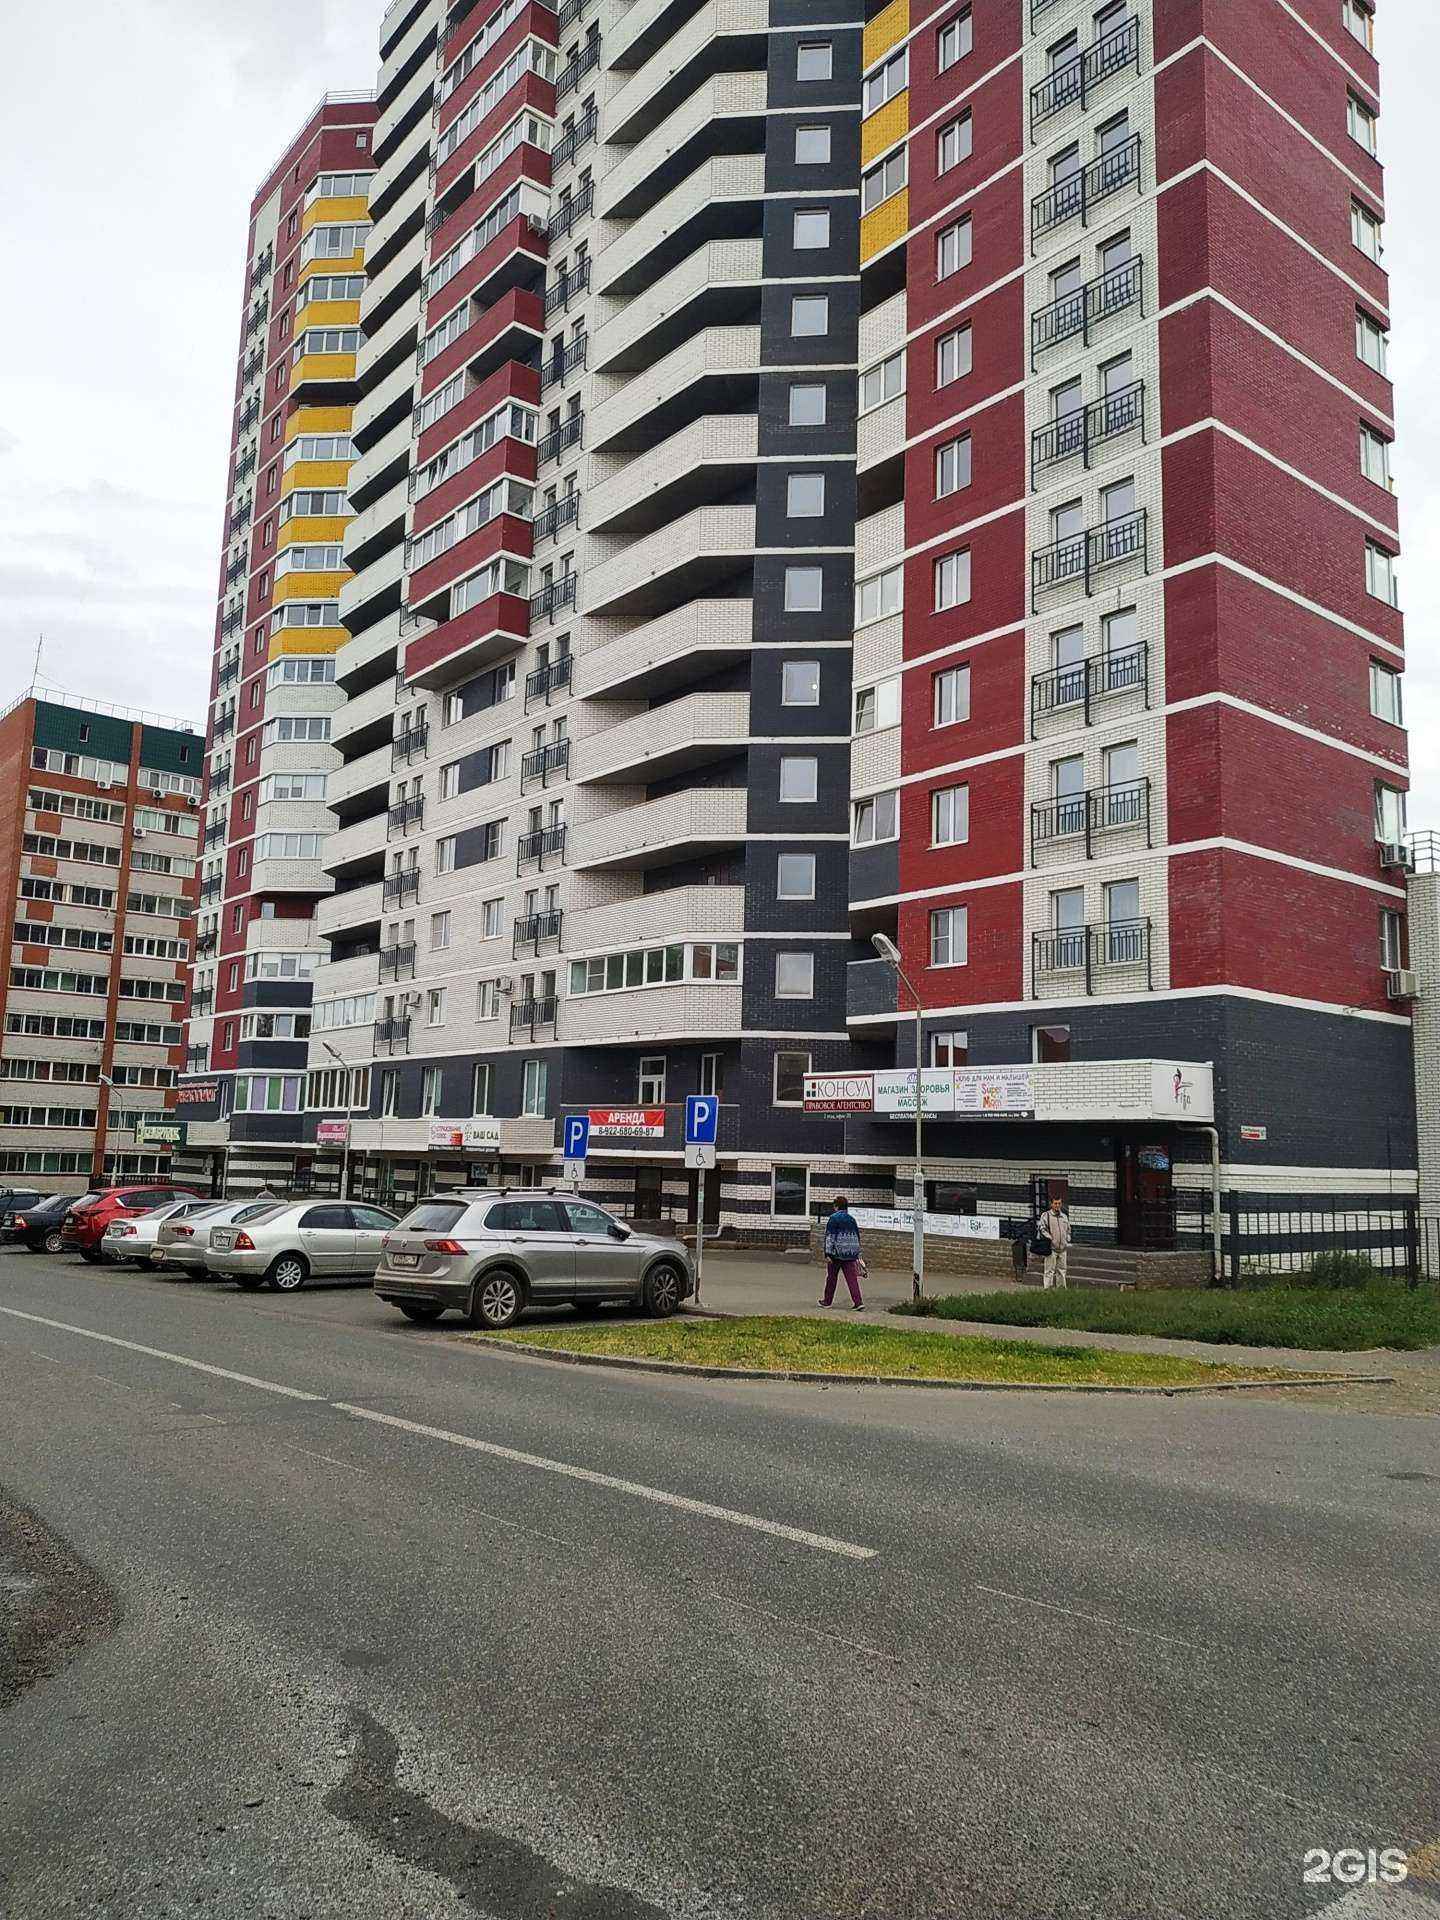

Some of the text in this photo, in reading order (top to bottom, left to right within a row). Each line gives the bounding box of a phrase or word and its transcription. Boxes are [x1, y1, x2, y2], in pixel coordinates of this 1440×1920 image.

[817, 1080, 871, 1098] КОНСУЛ
[878, 1085, 909, 1095] МАГАЗИН
[911, 1083, 950, 1095] ЗОРОВЬЯ
[805, 1100, 871, 1110] ПРАВОВОЕ АГЕНТСТВО
[897, 1098, 928, 1107] МАССЖ
[607, 1112, 646, 1125] АРЕНДА
[693, 1101, 710, 1138] P
[473, 1130, 499, 1140] ВАШ САД
[570, 1121, 583, 1154] P
